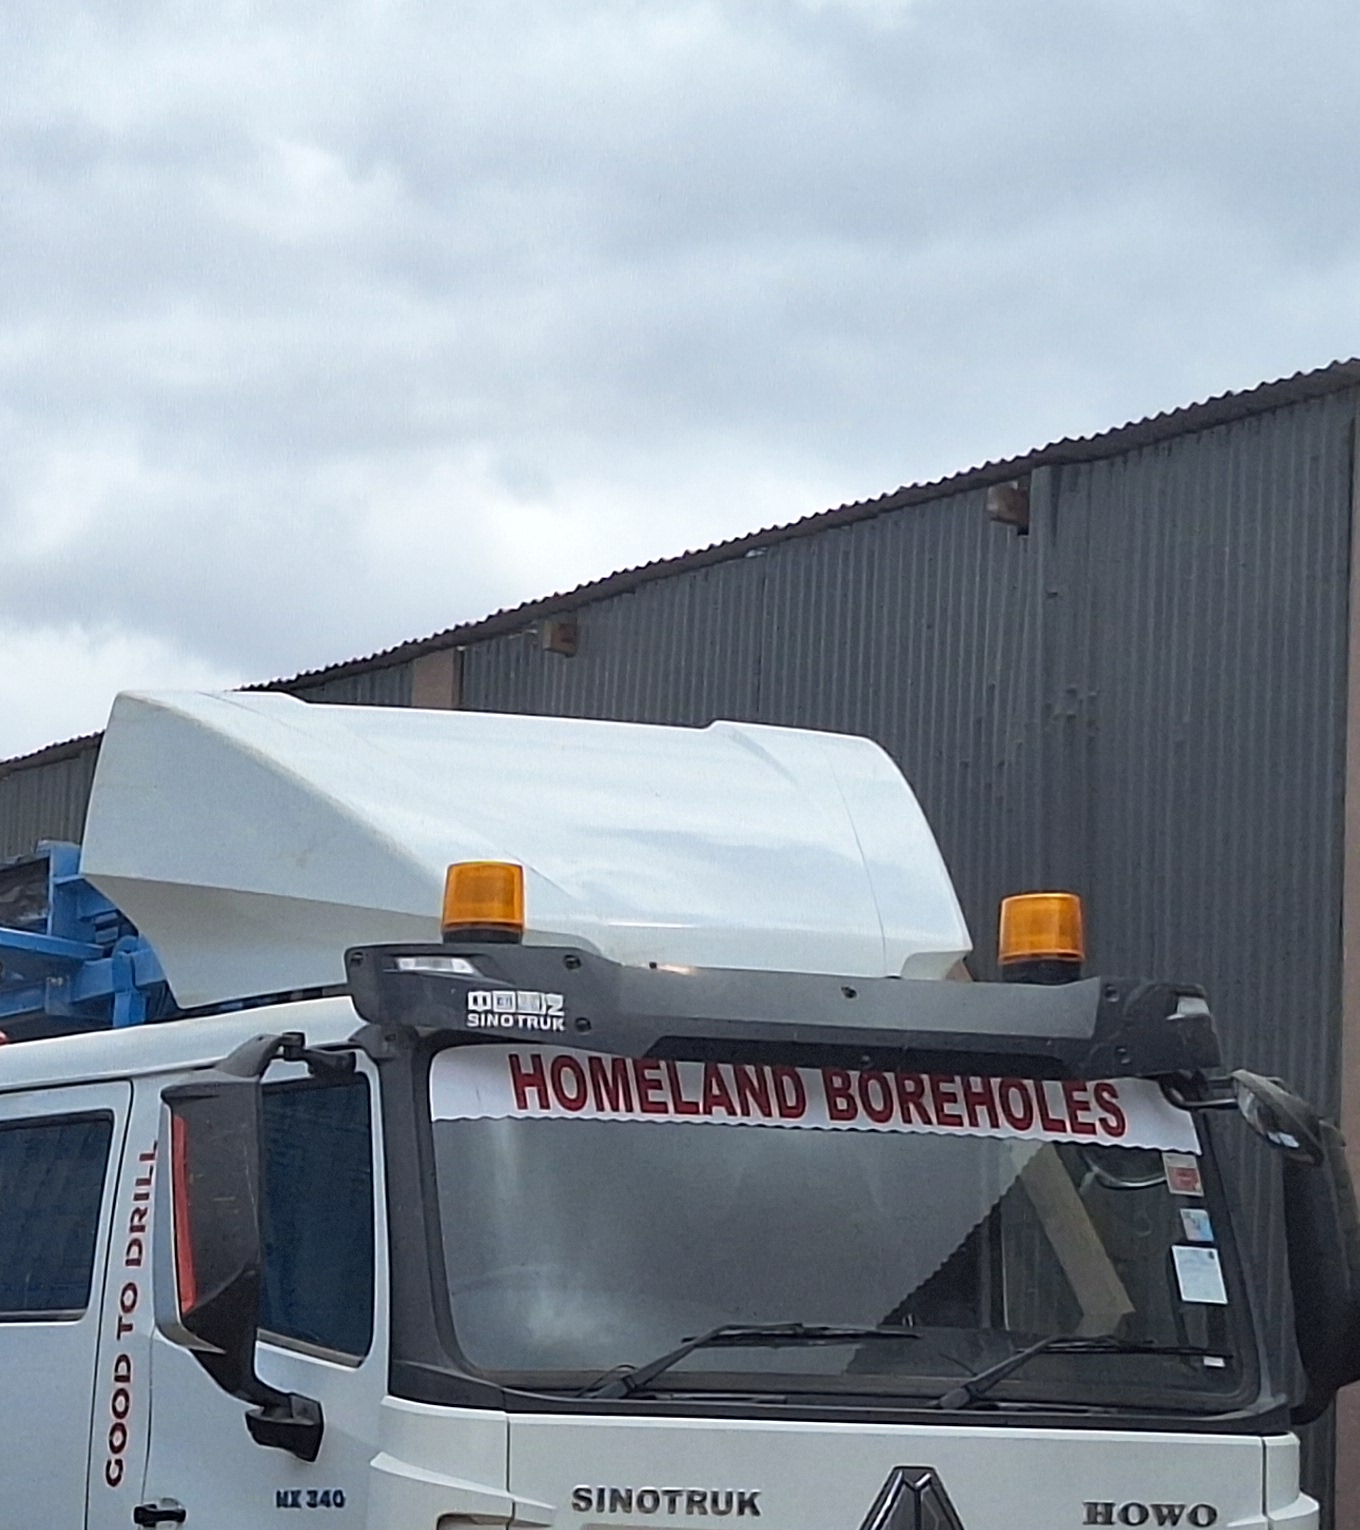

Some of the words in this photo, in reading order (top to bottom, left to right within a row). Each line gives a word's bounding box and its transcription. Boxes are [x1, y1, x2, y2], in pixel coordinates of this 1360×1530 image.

[467, 1013, 565, 1032] SINOTRUK
[508, 1053, 808, 1119] HOMELAND
[821, 1068, 1127, 1138] BOREHOLES
[125, 1140, 158, 1267] DRILL
[116, 1281, 138, 1341] TO
[105, 1353, 132, 1488] GOOD
[306, 1489, 346, 1509] 340
[571, 1485, 762, 1517] SINOTRUK
[1082, 1500, 1219, 1528] HOWO
